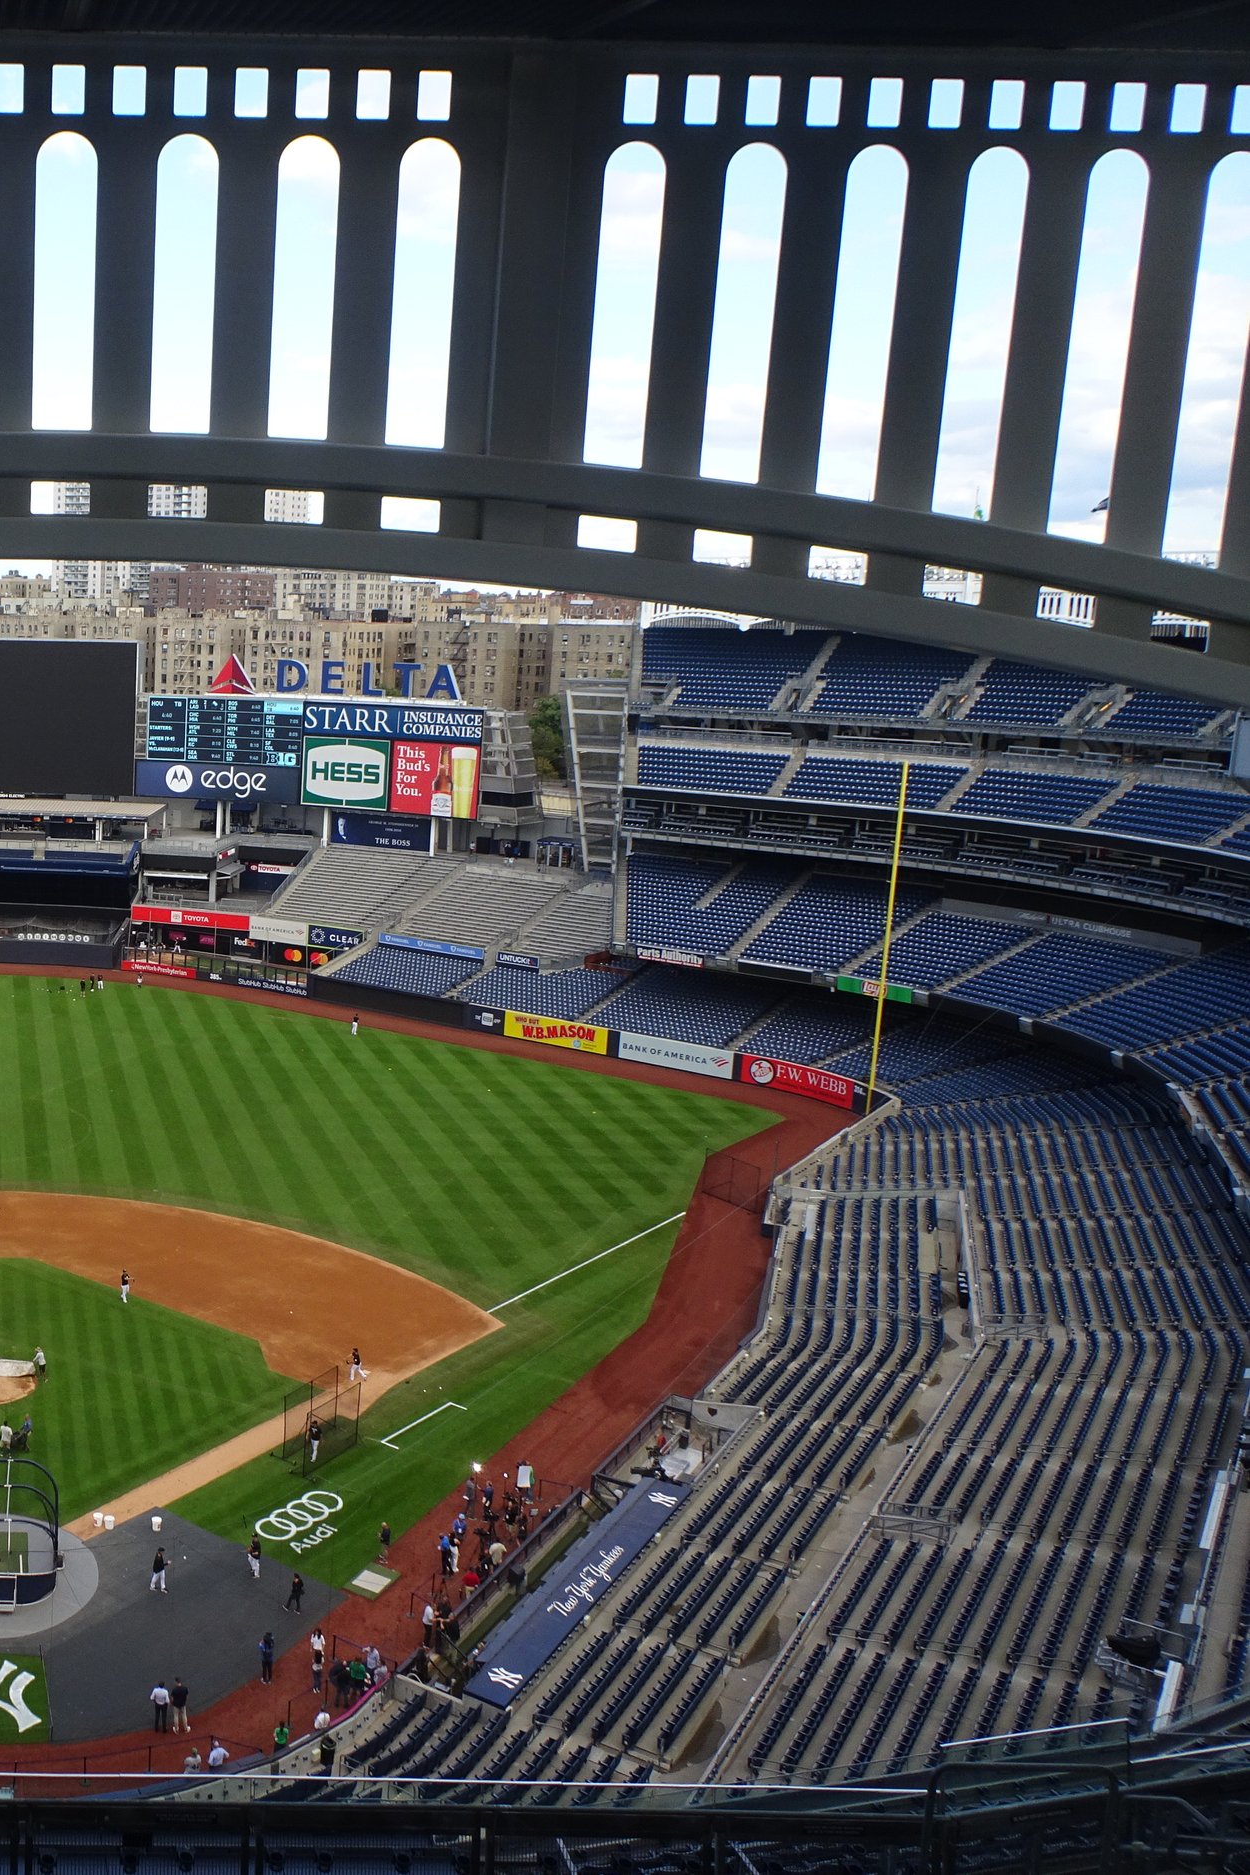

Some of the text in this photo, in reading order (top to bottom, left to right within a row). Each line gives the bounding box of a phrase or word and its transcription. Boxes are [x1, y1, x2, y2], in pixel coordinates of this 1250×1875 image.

[276, 658, 462, 700] DELTA
[304, 706, 392, 733] STARR
[404, 711, 482, 726] INSURANCE
[402, 724, 482, 738] COMPANIES
[398, 746, 426, 758] This
[312, 760, 380, 784] HESS
[397, 759, 430, 772] Bud's
[200, 766, 266, 798] edge
[396, 771, 418, 784] For
[396, 784, 422, 796] You.
[184, 914, 209, 923] TOYOTA
[1051, 917, 1131, 938] ULTRA CLUBHOUSE
[234, 937, 255, 948] FedEx
[330, 933, 360, 945] CLEAR
[637, 947, 660, 958] Parts
[661, 949, 703, 965] Authority
[238, 978, 261, 987] StubHub
[263, 982, 284, 992] StubHub
[286, 986, 307, 996] StubHub
[622, 1043, 707, 1065] BANK OF AMERICA
[776, 1064, 802, 1082] F.W.
[807, 1072, 847, 1095] WEBB
[648, 1491, 678, 1508] NY
[289, 1523, 338, 1554] Audi
[547, 1544, 625, 1617] New York Yankees
[487, 1667, 523, 1689] NY
